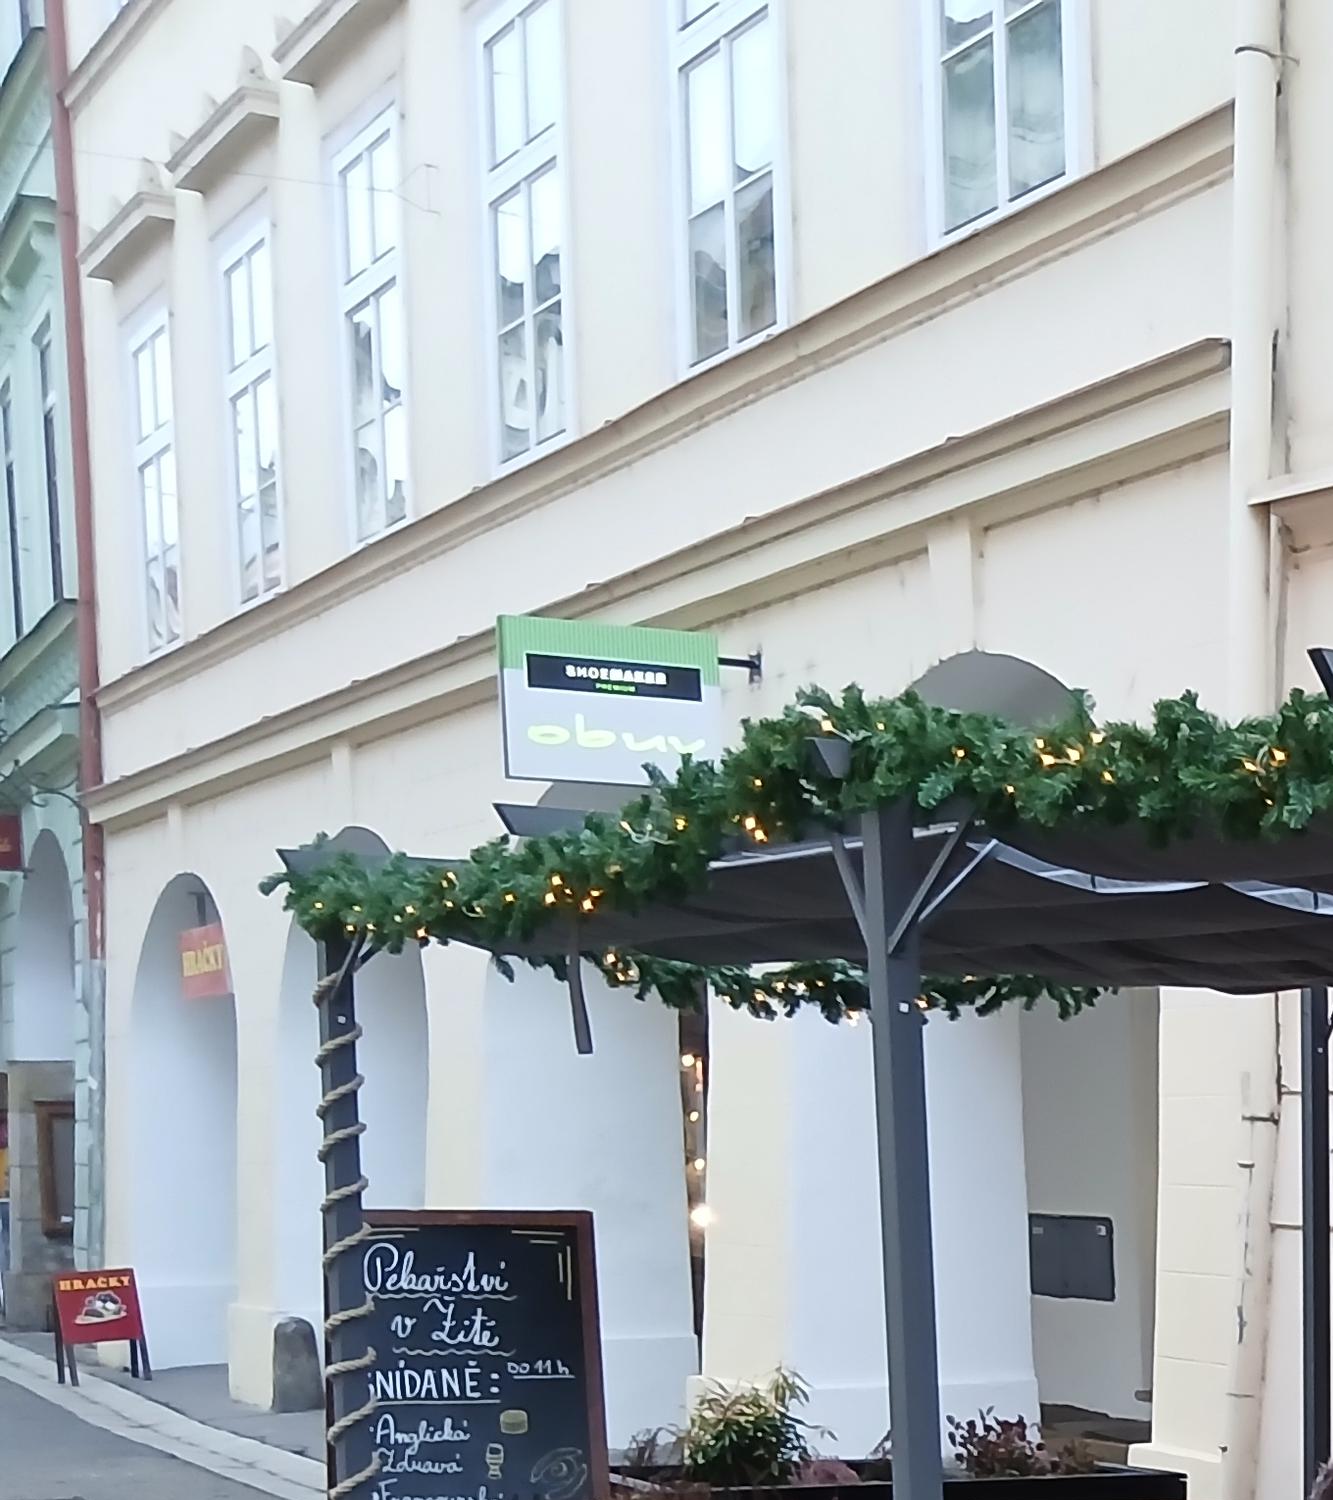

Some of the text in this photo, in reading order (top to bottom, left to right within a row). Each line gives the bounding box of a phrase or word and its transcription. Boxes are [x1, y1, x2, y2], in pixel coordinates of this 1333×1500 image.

[364, 1243, 508, 1292] Pekařství
[390, 1296, 499, 1347] v Žitě
[533, 1360, 552, 1373] 11
[376, 1413, 470, 1454] Anglická
